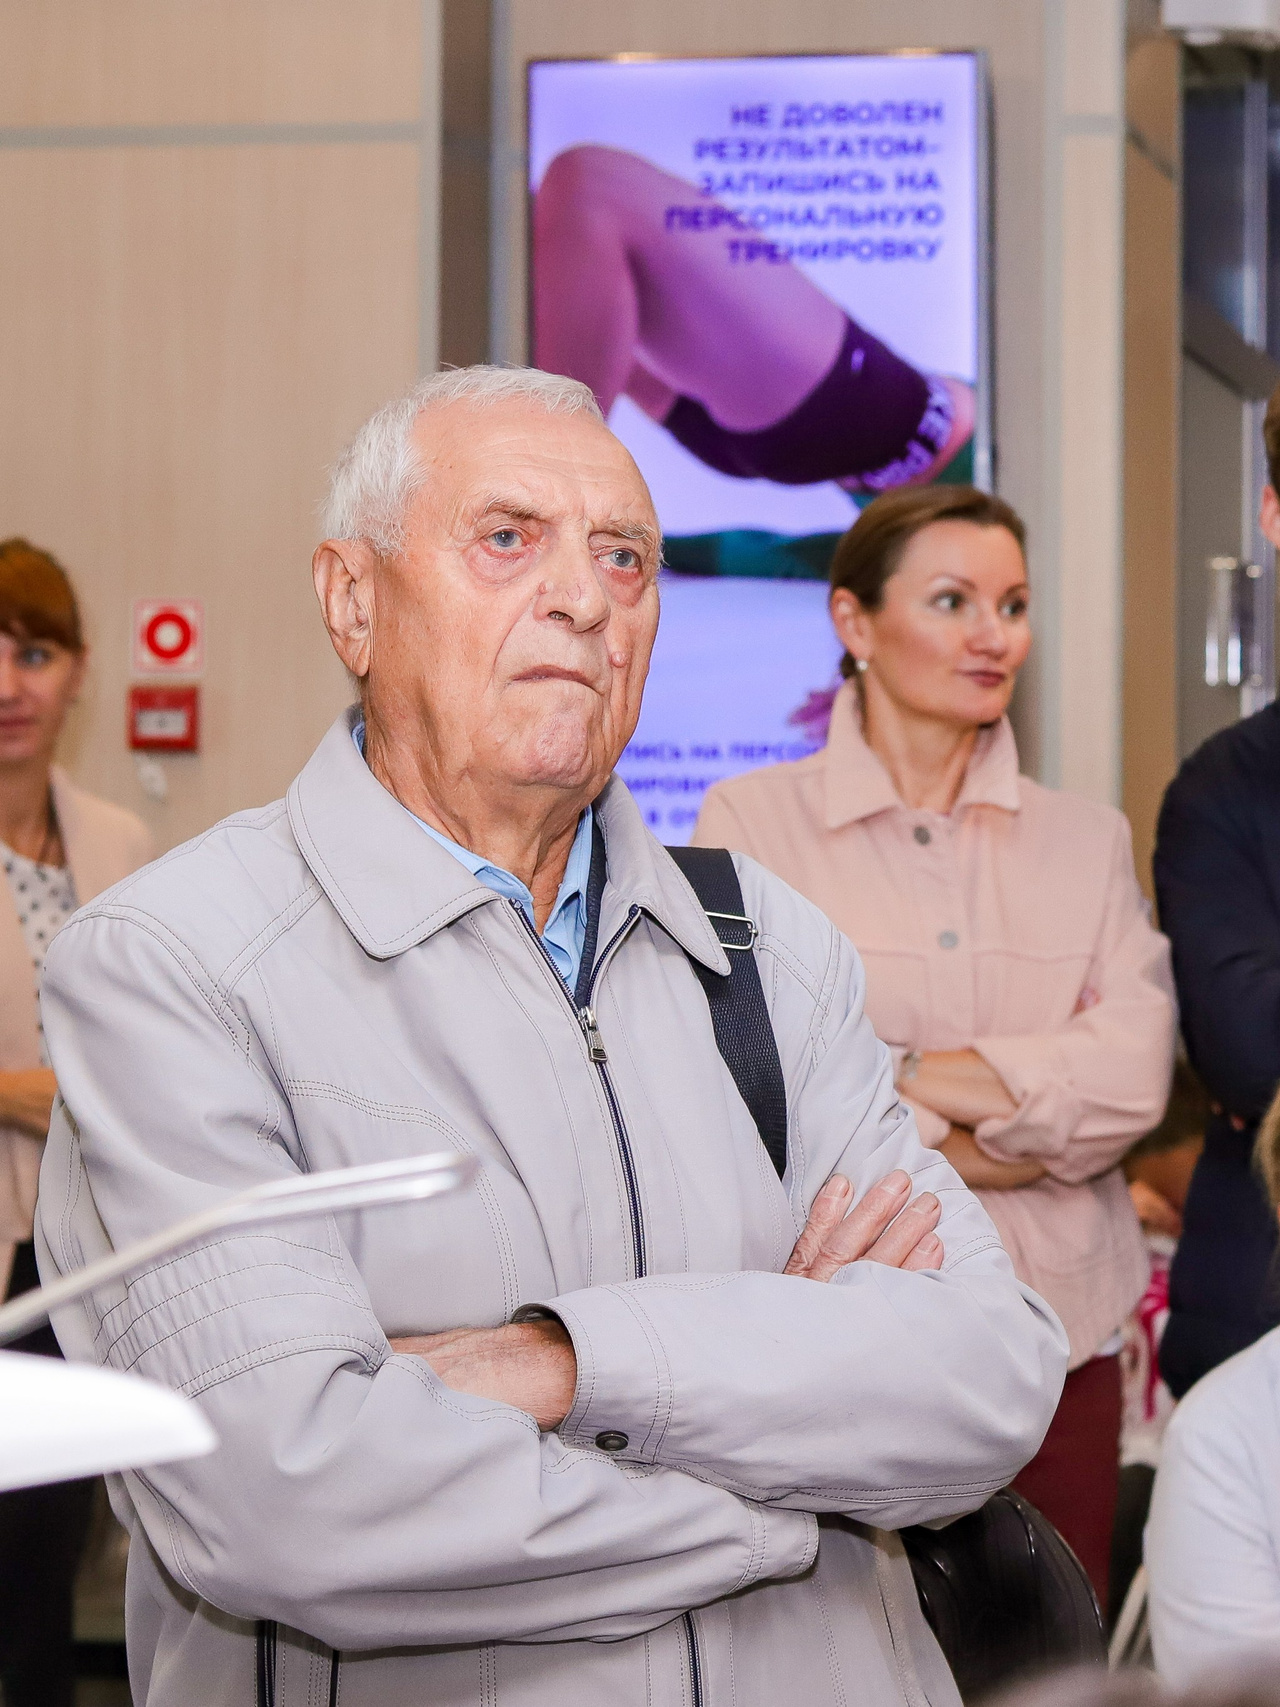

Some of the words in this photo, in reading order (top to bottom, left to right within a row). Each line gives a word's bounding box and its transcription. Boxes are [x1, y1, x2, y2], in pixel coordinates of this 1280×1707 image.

[730, 103, 769, 128] НЕ
[780, 101, 943, 128] ДОВОЛЕН
[700, 170, 884, 196] ЗАПИШИСЬ
[895, 168, 940, 193] НА
[664, 203, 945, 231] ПЕРСОНАЛЬНУЮ
[727, 237, 942, 264] ТРЕНИРОВКУ
